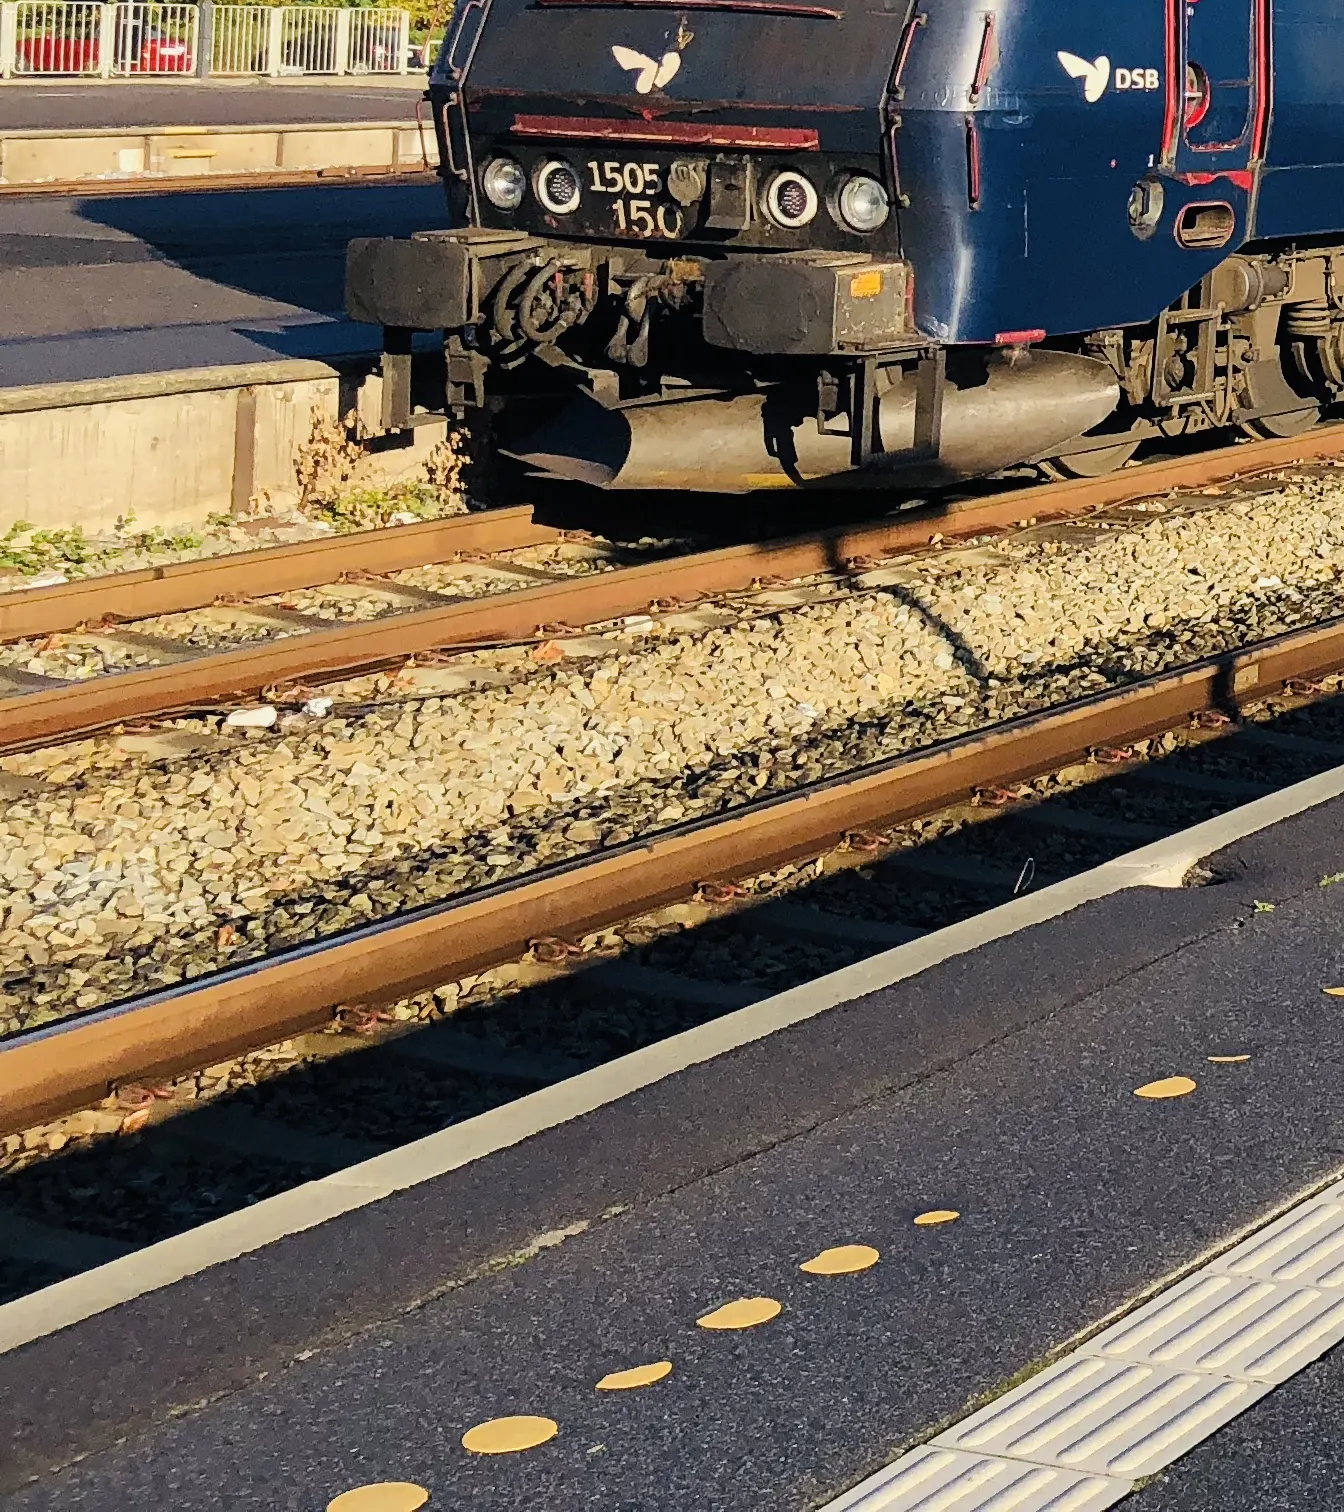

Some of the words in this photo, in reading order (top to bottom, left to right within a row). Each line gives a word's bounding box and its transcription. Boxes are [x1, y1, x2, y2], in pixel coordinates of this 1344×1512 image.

[1115, 68, 1159, 89] DSB
[1148, 154, 1154, 167] 1
[587, 161, 662, 194] 1505
